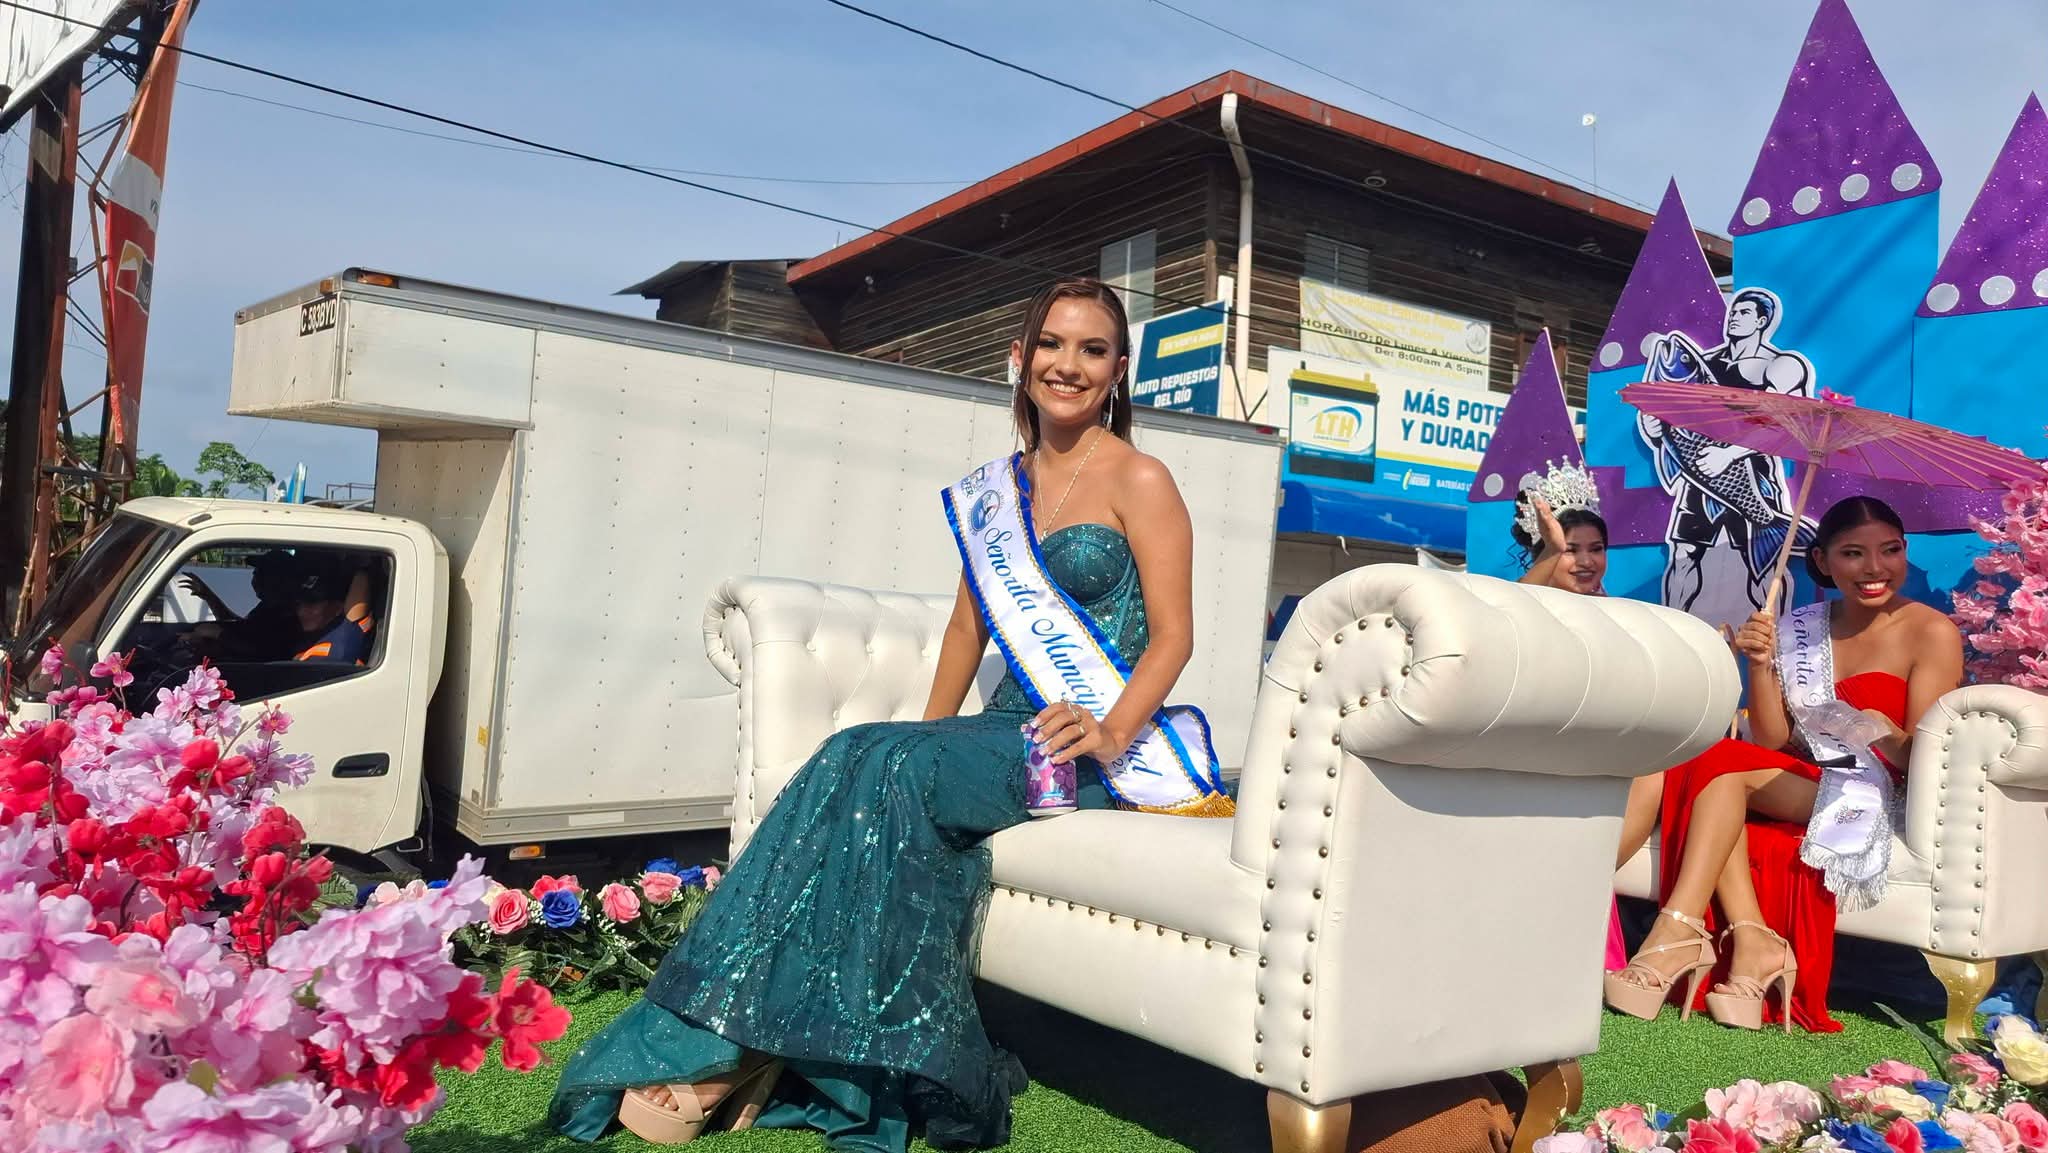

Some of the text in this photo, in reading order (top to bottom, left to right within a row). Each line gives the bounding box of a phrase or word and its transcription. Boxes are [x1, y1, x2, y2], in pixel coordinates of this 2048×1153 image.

[1398, 351, 1441, 368] 8:00am
[1133, 365, 1218, 397] AUTO REPUESTOS
[1153, 385, 1192, 407] DEL RÍO
[1403, 388, 1505, 428] MÁS POTE
[1401, 418, 1491, 454] Y DURAD
[984, 527, 1038, 612] Señorita
[1791, 606, 1817, 688] Señorita
